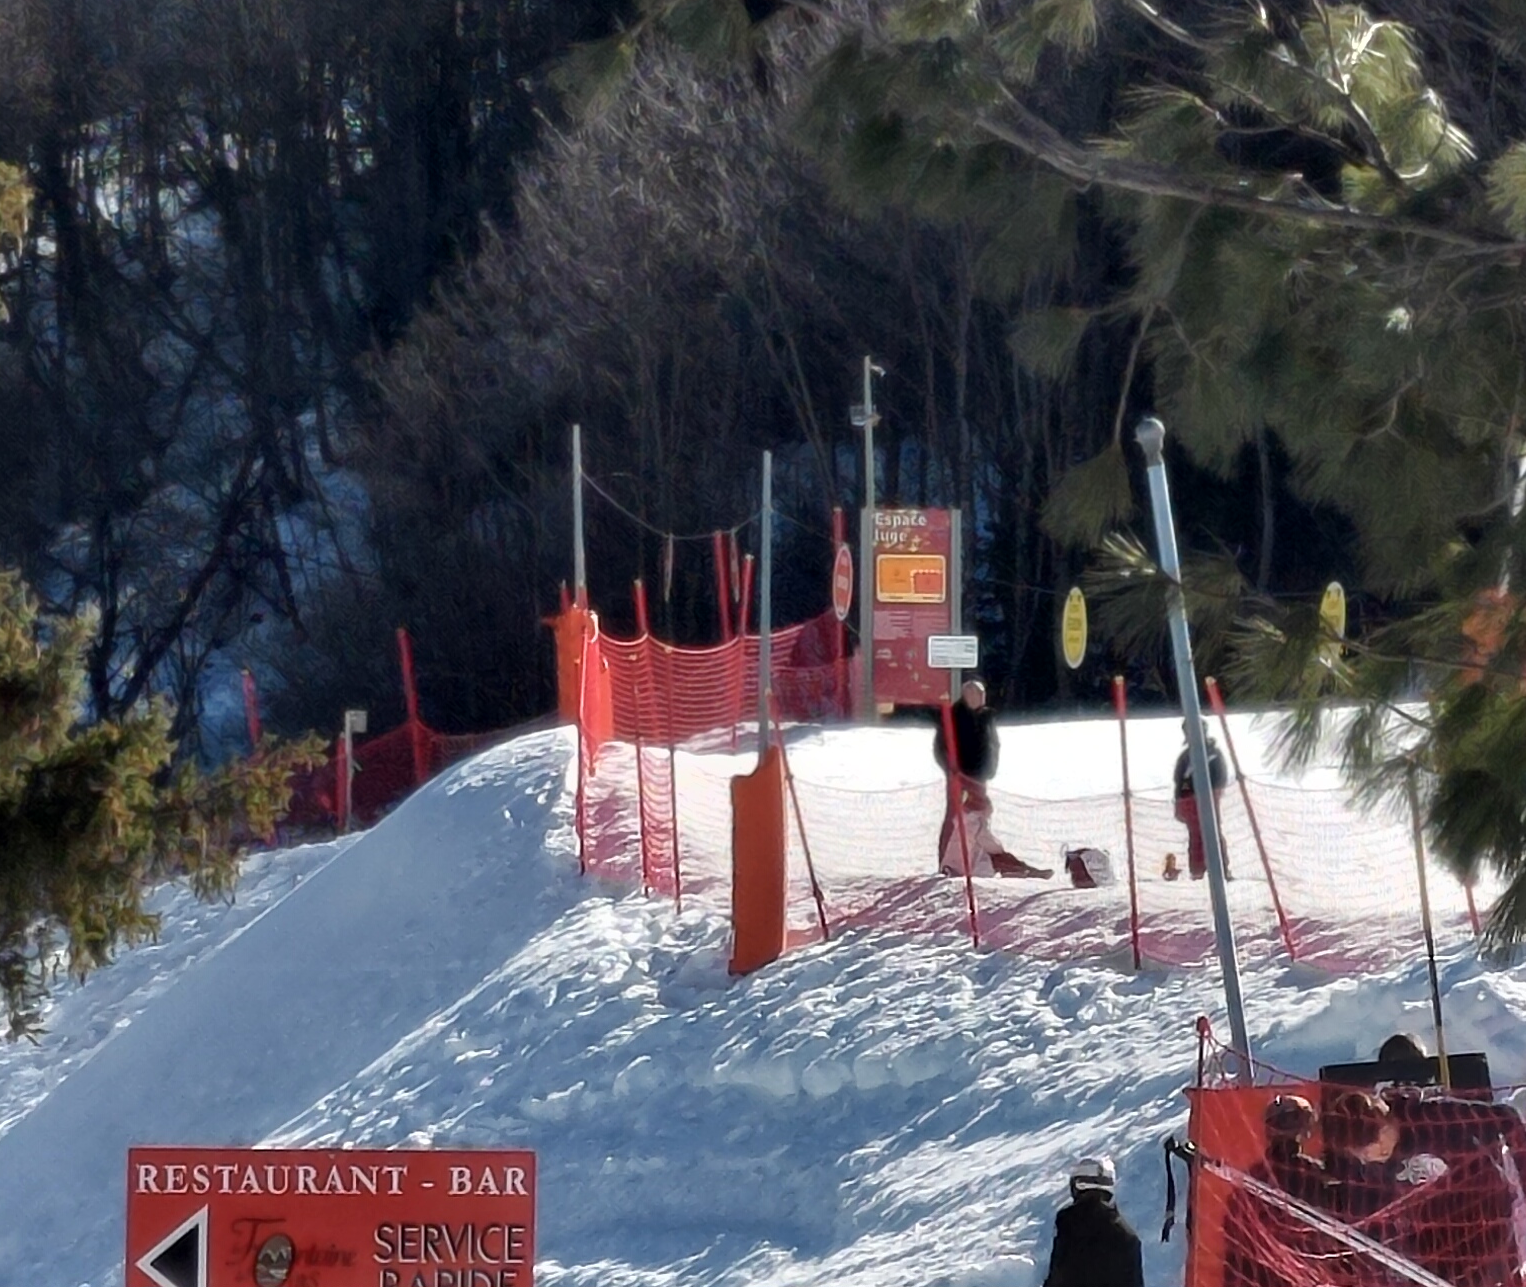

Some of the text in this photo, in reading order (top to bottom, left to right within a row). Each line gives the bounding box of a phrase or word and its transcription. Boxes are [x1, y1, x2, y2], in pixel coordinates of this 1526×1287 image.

[875, 512, 928, 529] Espace
[875, 528, 908, 543] luge
[135, 1163, 407, 1195] RESTAURANT
[448, 1166, 529, 1195] BAR
[373, 1223, 526, 1264] SERVICE
